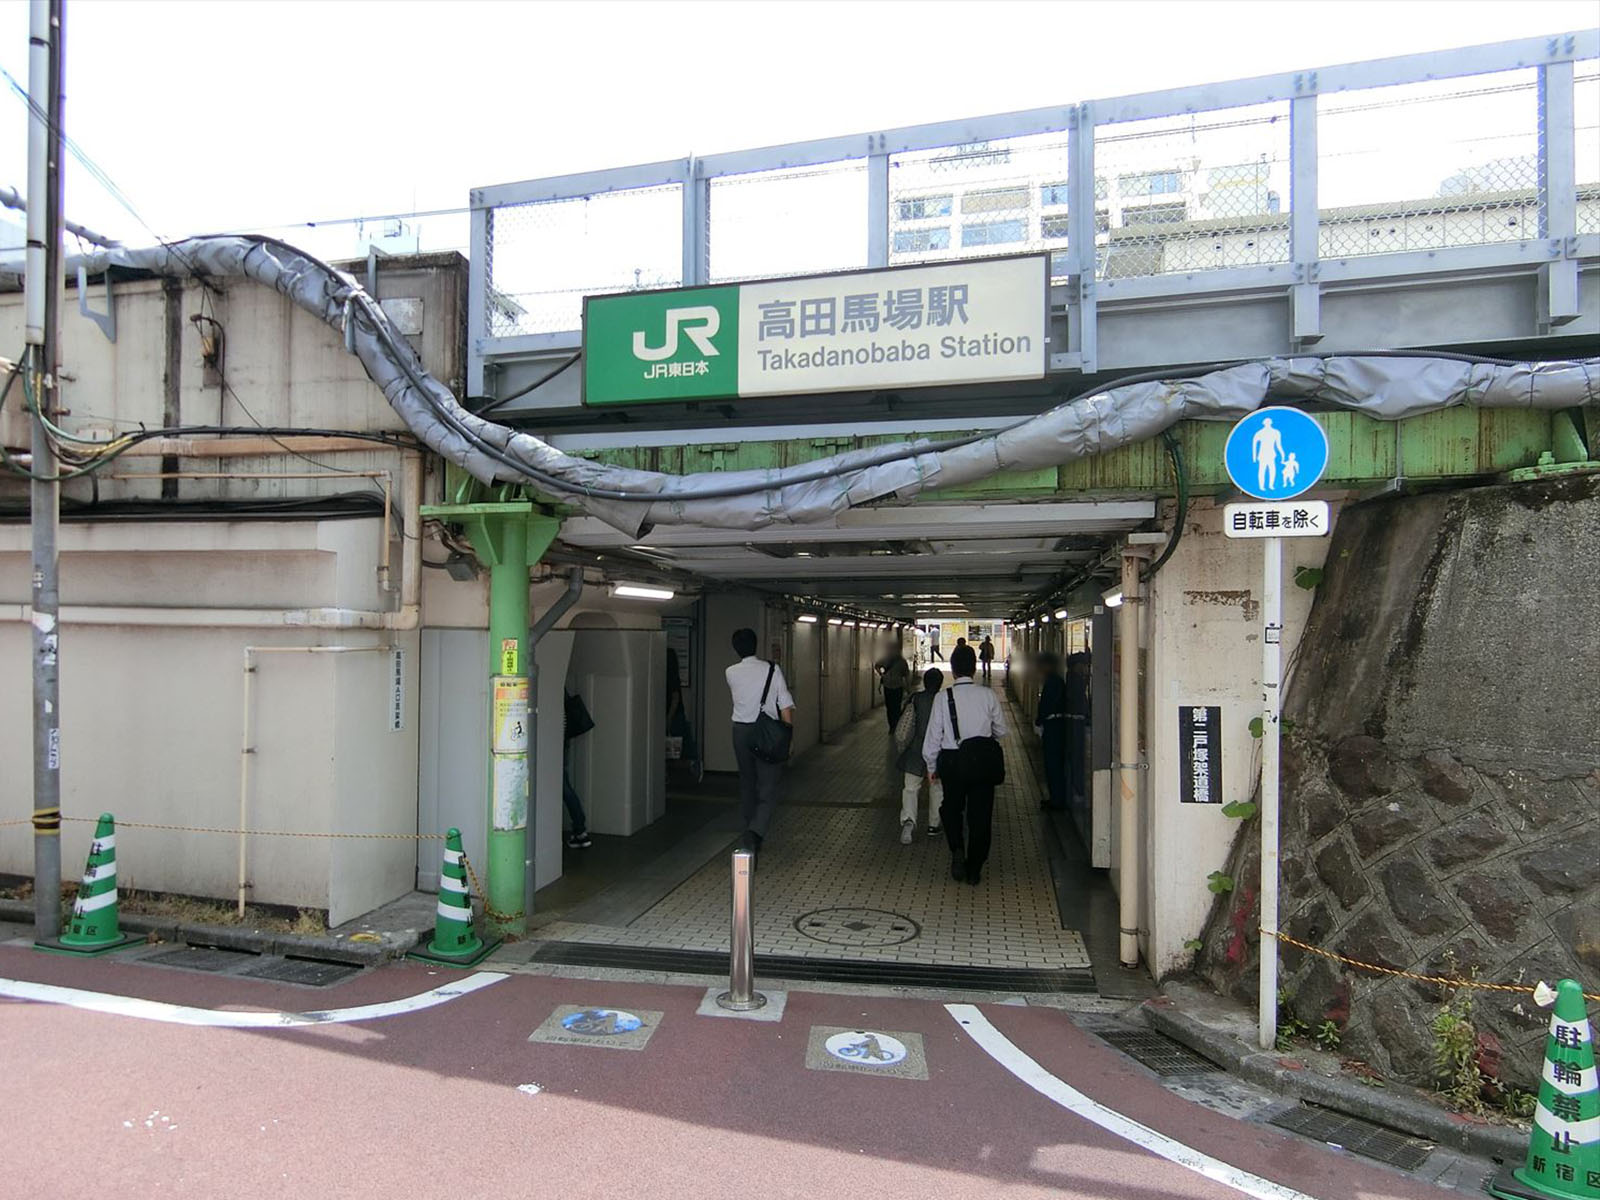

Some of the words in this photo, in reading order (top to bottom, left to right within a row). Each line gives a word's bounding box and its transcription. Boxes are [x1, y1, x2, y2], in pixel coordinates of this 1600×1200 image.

[632, 305, 721, 361] JR
[757, 284, 969, 342] 高田馬場駅
[643, 360, 710, 380] JR東日本
[757, 338, 930, 372] Takadanobaba
[940, 333, 1032, 359] Station
[1233, 509, 1319, 530] 自転車を除く
[1551, 1024, 1582, 1154] 駐輪禁止
